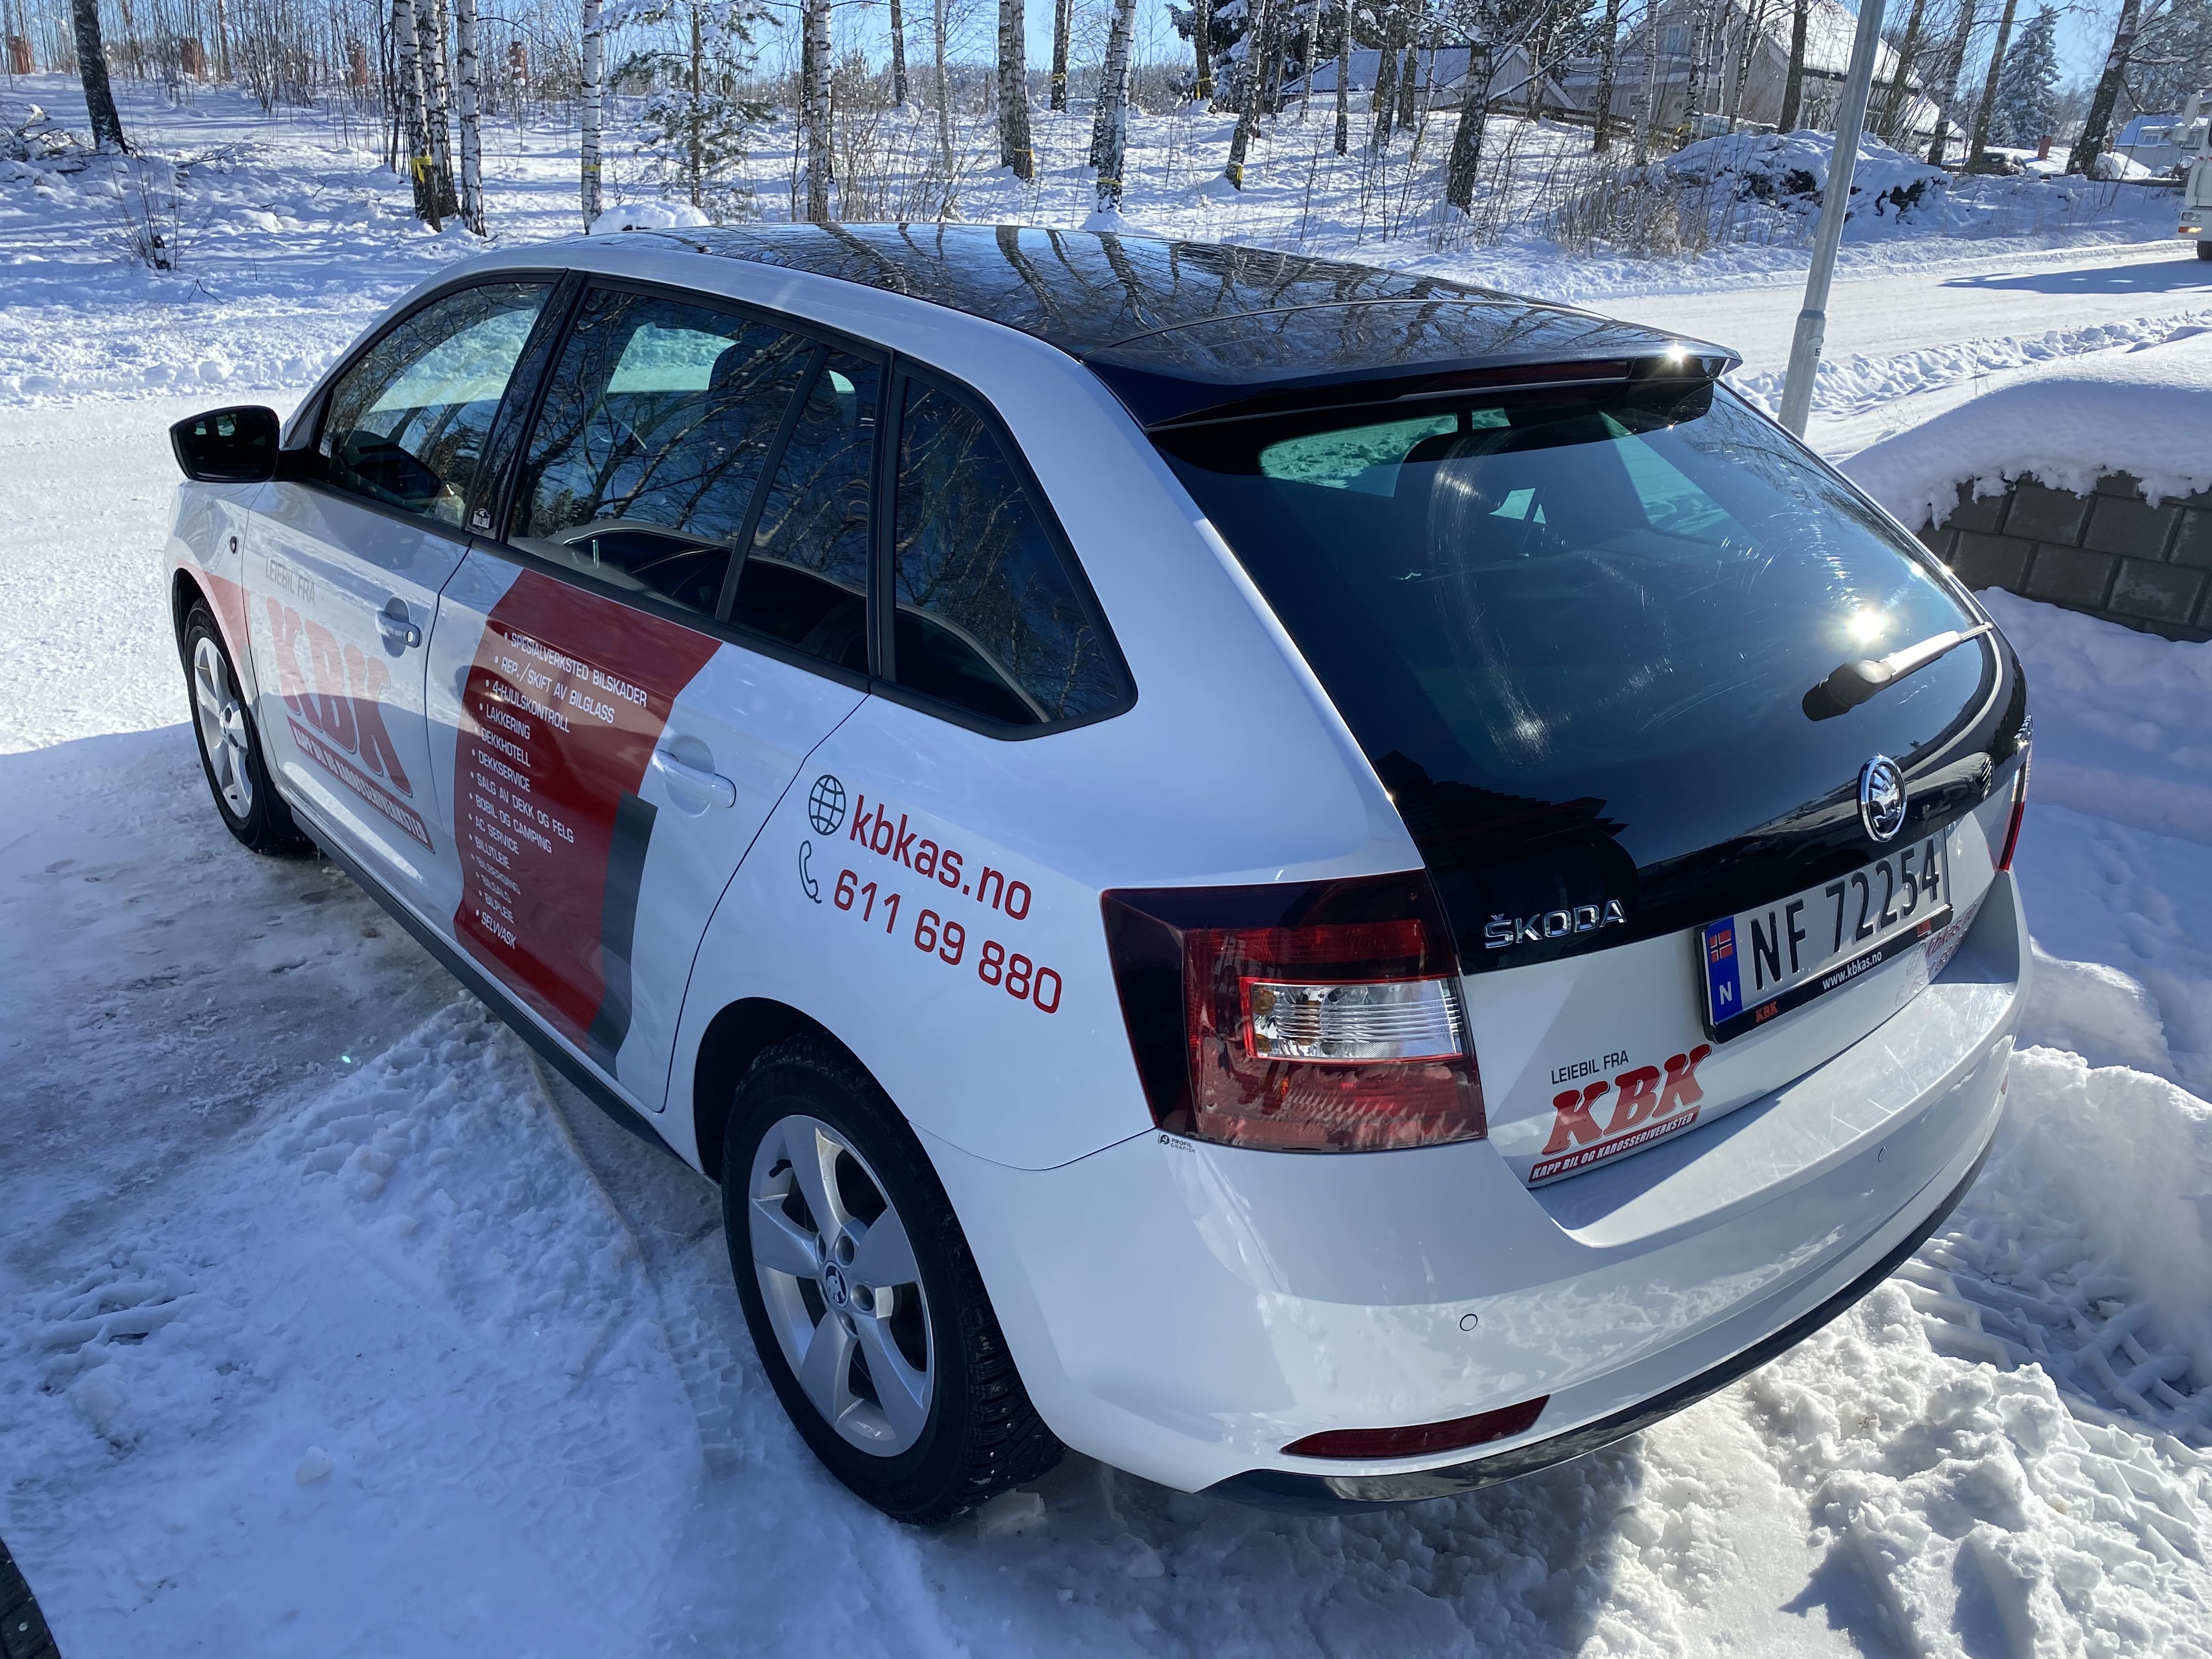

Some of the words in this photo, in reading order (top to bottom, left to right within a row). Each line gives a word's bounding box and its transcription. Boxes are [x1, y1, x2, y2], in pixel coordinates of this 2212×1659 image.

[265, 556, 295, 596] LEIEBIL
[297, 574, 315, 606] FRA
[511, 632, 589, 680] SPESIALVERKSTED
[592, 669, 647, 707] BILSKADER
[267, 596, 413, 798] KBK
[492, 680, 571, 733] 4-HJULSKONTROLL
[554, 682, 568, 700] AV
[569, 690, 615, 724] BILGLASS
[486, 703, 531, 740] LAKKERING
[482, 727, 531, 768] DEKKHOTELL
[478, 749, 531, 793] DEKKSERVICE
[475, 794, 498, 819] BOBIL
[499, 809, 511, 827] OG
[513, 819, 552, 854] CAMPING
[477, 772, 496, 795] SALG
[500, 787, 509, 804] AV
[512, 794, 535, 820] DEKK
[537, 809, 549, 828] OG
[552, 818, 574, 843] FELG
[475, 816, 486, 832] AC
[487, 824, 519, 855] SERVICE
[475, 836, 511, 870] BILUTLEIE
[849, 794, 1031, 921] kbkas.no
[484, 892, 515, 924] BILPLEIE
[1484, 899, 1627, 949] ŠKODA
[1750, 898, 1807, 991] NF
[1825, 838, 1940, 953] 72254
[833, 869, 901, 934] 611
[914, 909, 966, 966] 69
[978, 940, 1062, 1014] 880
[1822, 951, 1882, 990] www.kbkas.no
[1719, 981, 1733, 1005] N
[1756, 1002, 1779, 1023] KBK
[1551, 1059, 1600, 1085] LEIEBIL
[1604, 1049, 1629, 1070] FRA
[1541, 1043, 1712, 1155] KBK
[1170, 1143, 1196, 1153] GRAFISK
[1171, 1138, 1193, 1148] PROFIL
[1532, 1161, 1561, 1180] KAPP
[1562, 1156, 1579, 1171] BIL
[1581, 1150, 1595, 1164] OG
[1596, 1112, 1694, 1160] KAROSSERIVERKSTED
